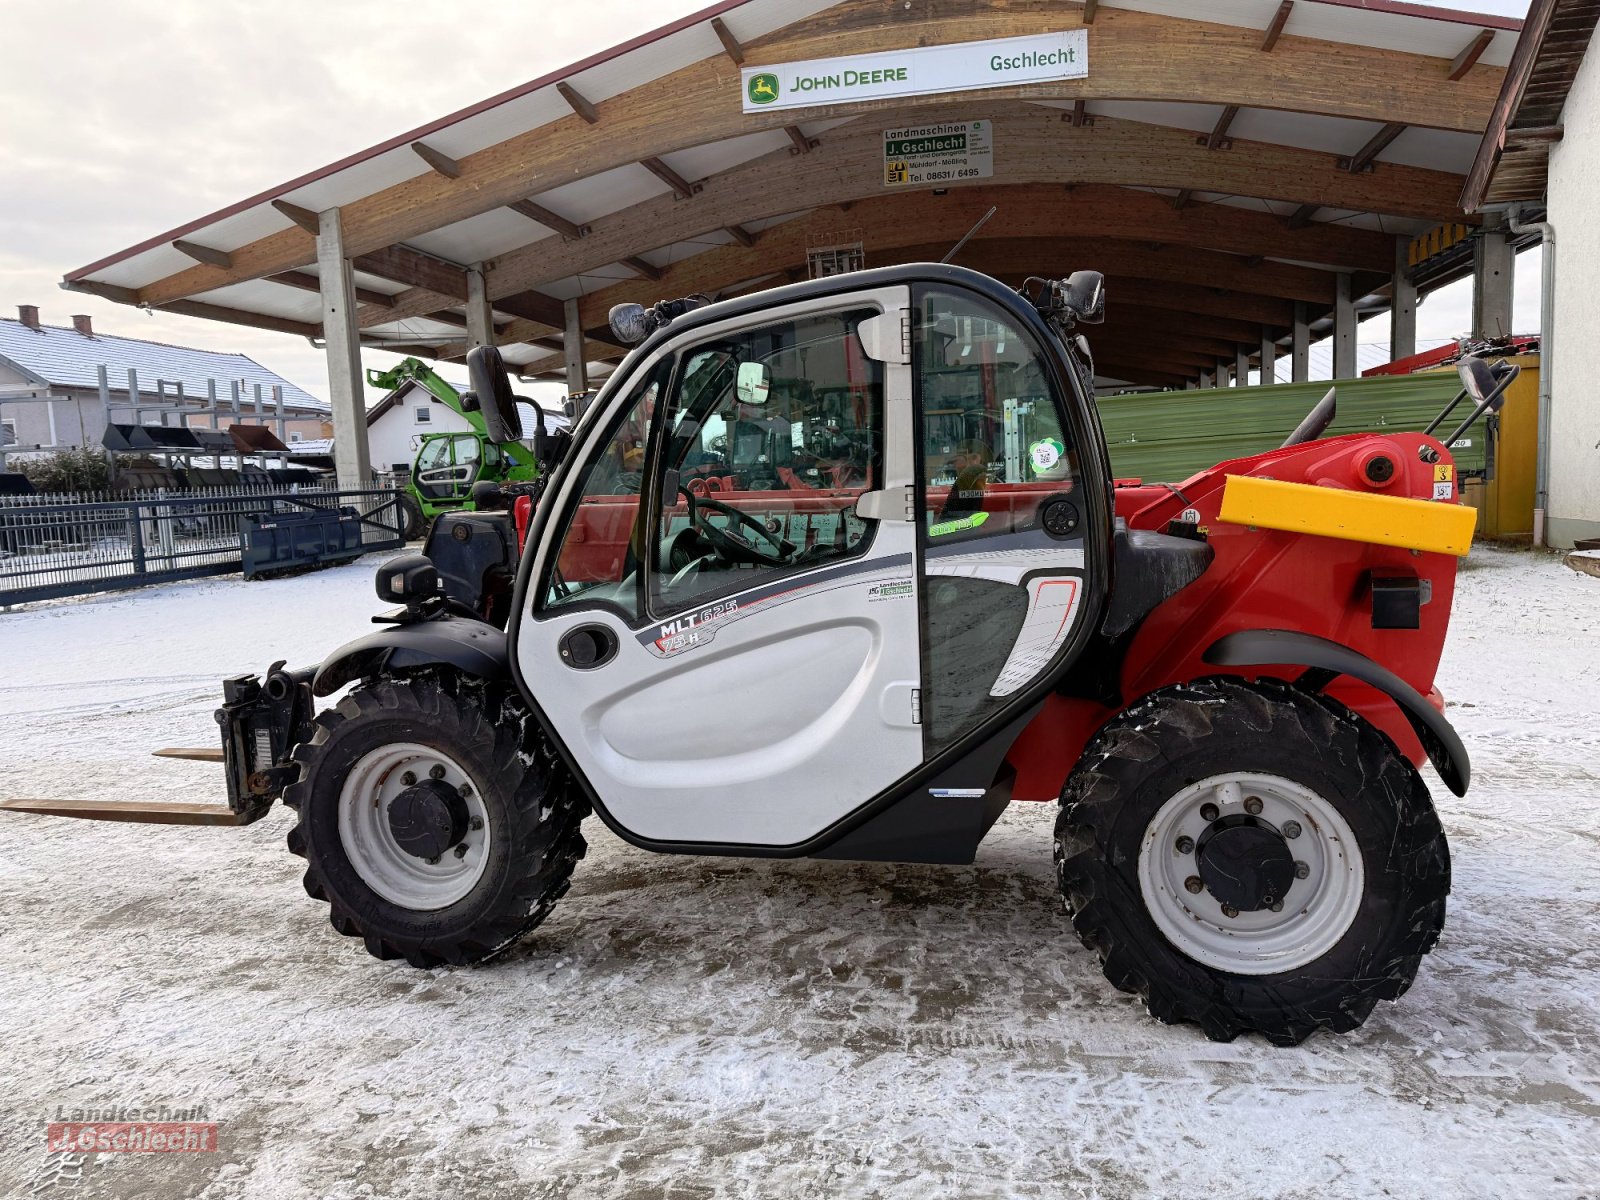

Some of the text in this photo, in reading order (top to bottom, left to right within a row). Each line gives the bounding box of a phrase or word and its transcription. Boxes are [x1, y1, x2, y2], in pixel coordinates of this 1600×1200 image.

[990, 48, 1075, 71] Gschlecht
[790, 67, 907, 92] JOHN DEERE
[885, 124, 967, 139] Landmaschinen
[888, 137, 964, 155] J. Gschlecht
[909, 173, 925, 182] Tel.
[958, 168, 979, 178] 6495
[661, 599, 738, 638] MLT 625
